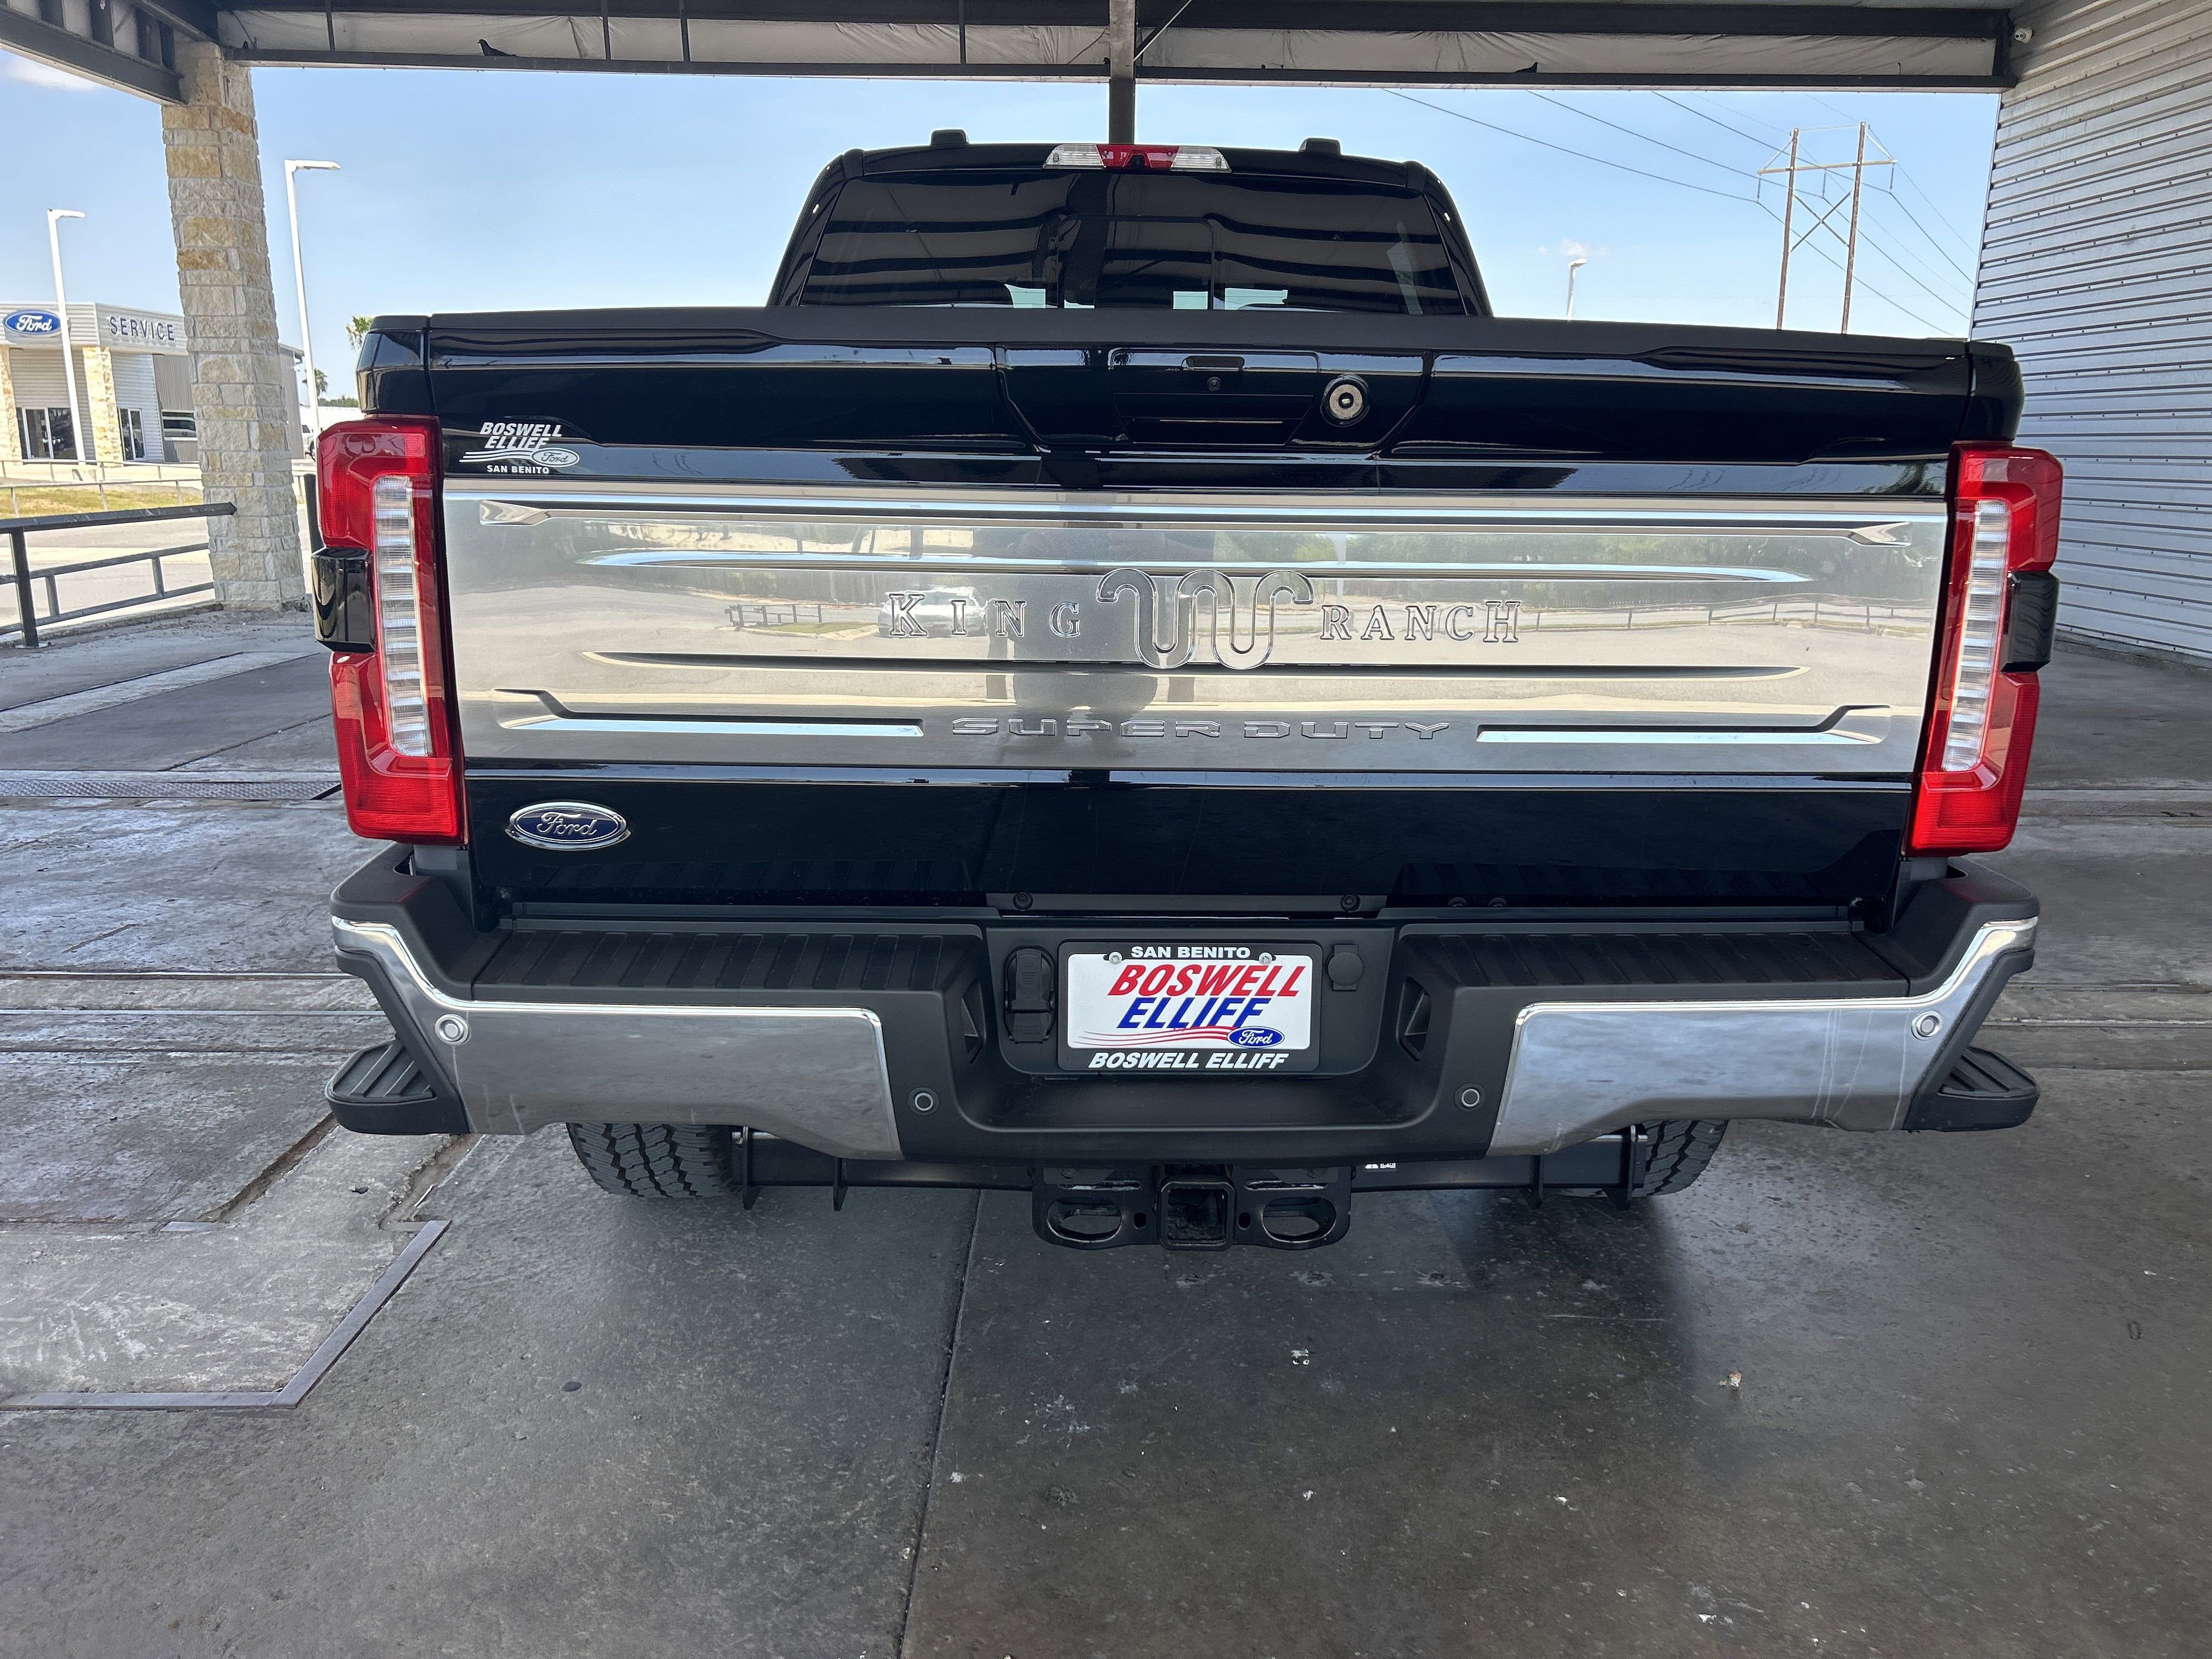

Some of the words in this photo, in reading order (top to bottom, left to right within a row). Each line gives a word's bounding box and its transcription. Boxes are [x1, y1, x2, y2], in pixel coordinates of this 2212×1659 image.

[16, 314, 53, 331] Ford
[109, 315, 174, 341] SERVICE
[479, 422, 562, 437] BOSWELL
[484, 436, 550, 449] ELLIFF
[540, 451, 569, 463] Ford
[487, 465, 507, 473] SAN
[511, 465, 550, 474] BENITO
[888, 592, 1081, 638] KING
[1319, 600, 1521, 643] RANCH
[952, 718, 1221, 738] SUPER
[1244, 720, 1449, 740] DUTY
[536, 811, 598, 836] Ford
[1131, 946, 1171, 958] SAN
[1177, 946, 1251, 959] BENITO
[1107, 963, 1306, 997] BOSWELL
[1115, 997, 1272, 1029] ELLIFF
[1238, 1029, 1274, 1046] Ford
[1087, 1052, 1200, 1069] BOSWELL
[1204, 1052, 1290, 1069] ELLIFF
